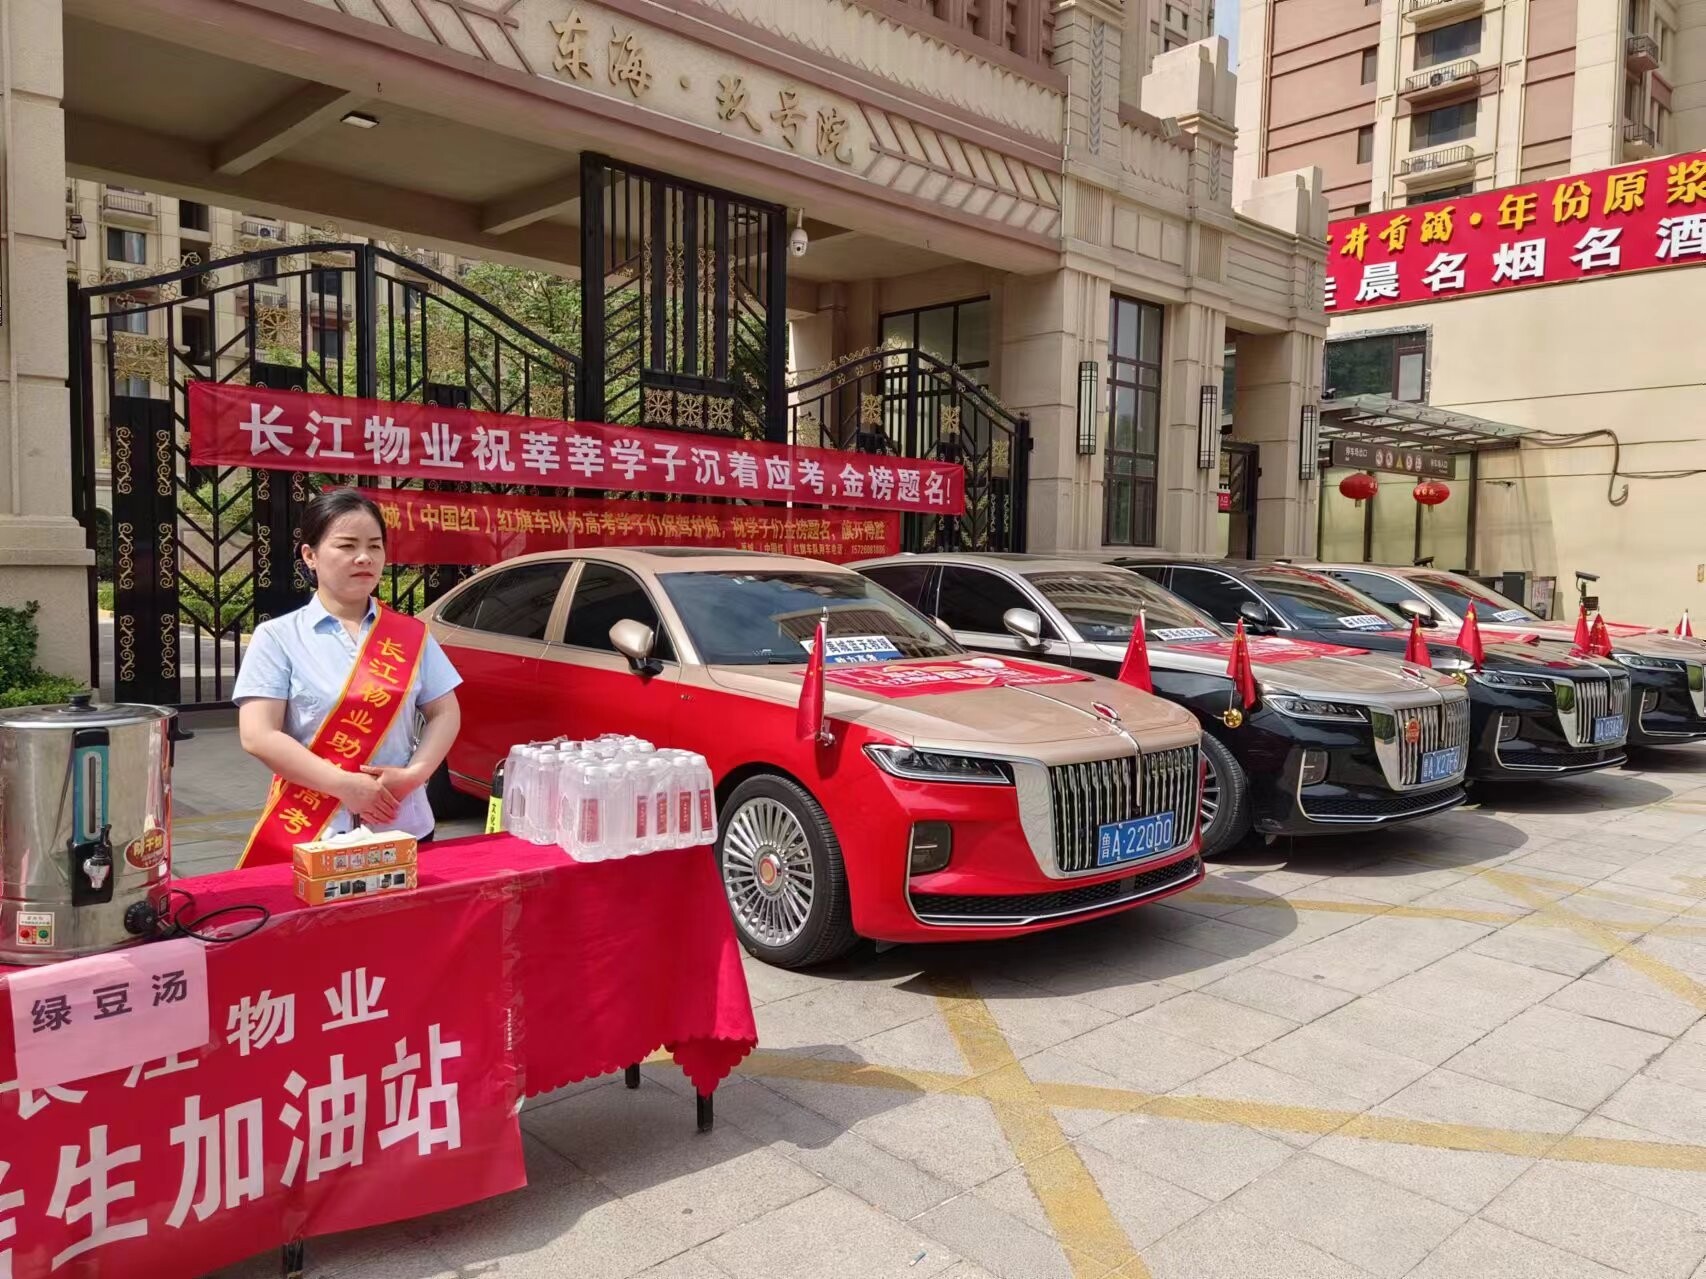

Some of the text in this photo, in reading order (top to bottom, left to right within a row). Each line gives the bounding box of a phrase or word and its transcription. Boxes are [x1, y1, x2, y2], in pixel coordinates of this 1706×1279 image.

[1328, 159, 1706, 261] 井贡酒·年份原浆
[32, 969, 188, 1034] 绿豆汤
